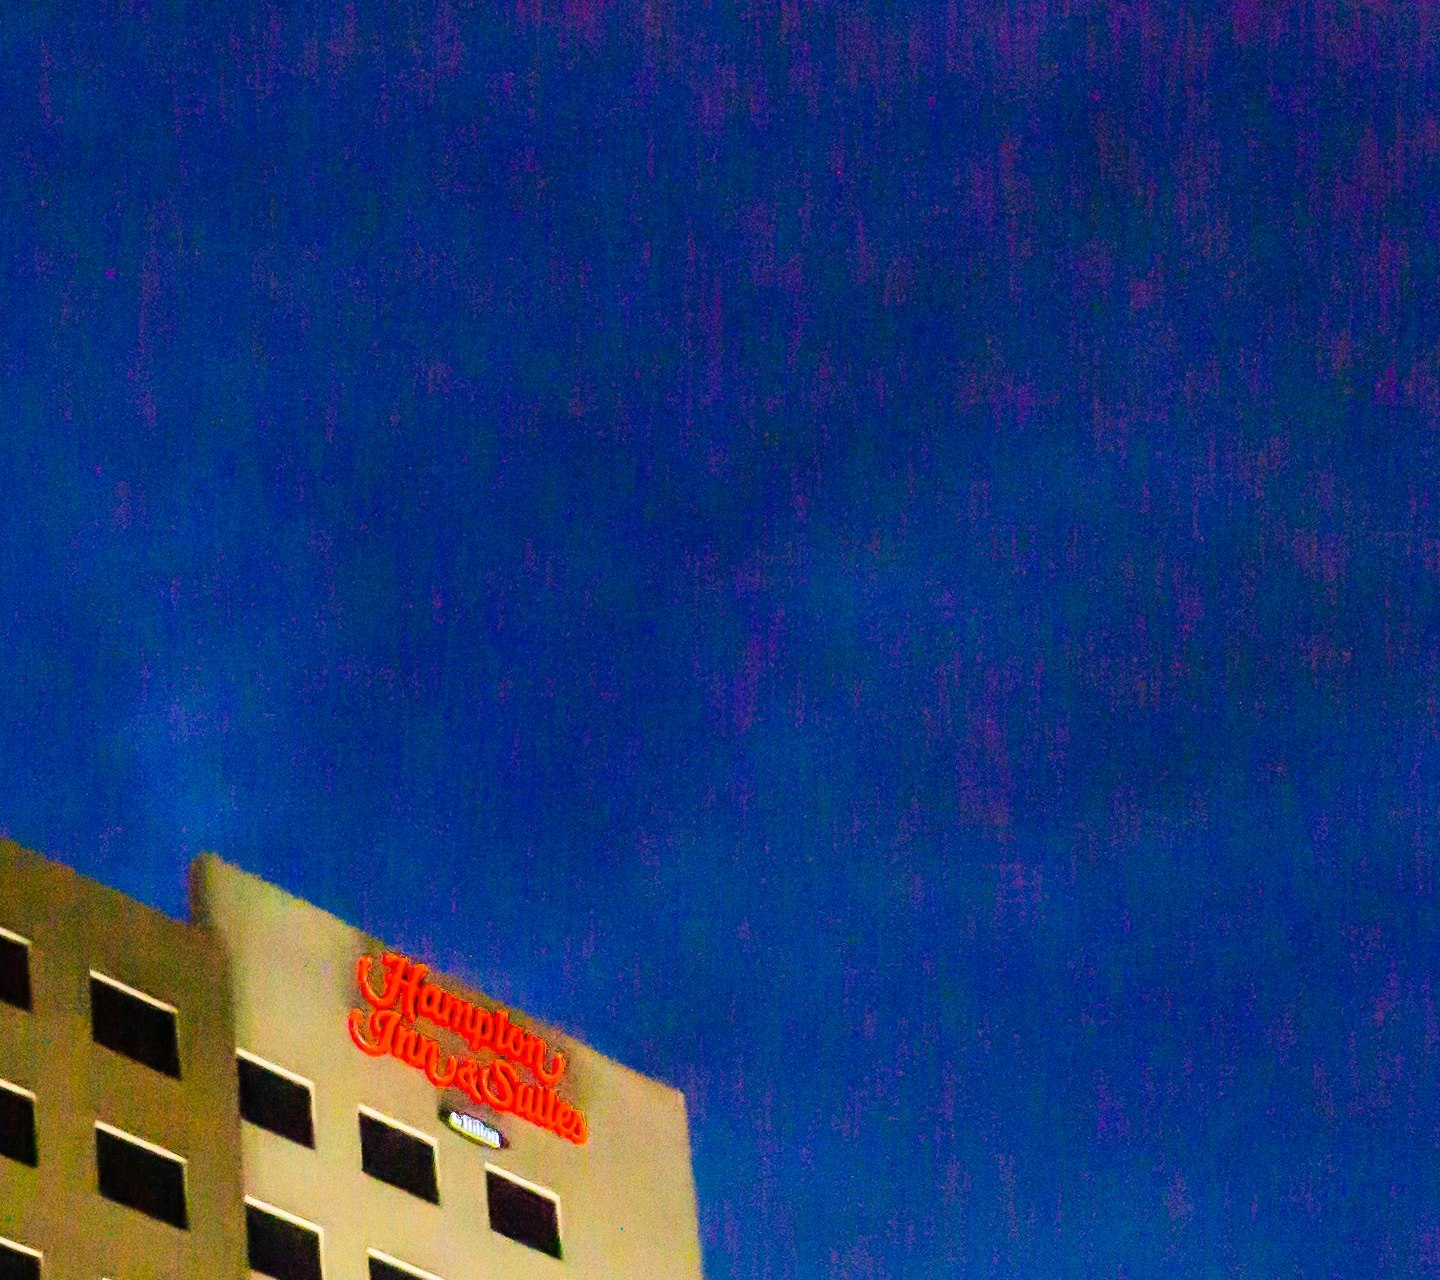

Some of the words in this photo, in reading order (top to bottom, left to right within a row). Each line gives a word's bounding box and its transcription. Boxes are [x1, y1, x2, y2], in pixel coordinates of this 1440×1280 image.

[348, 1008, 458, 1088] Inn
[456, 1056, 485, 1104] &
[481, 1058, 589, 1146] Suites
[356, 950, 566, 1086] Hampton
